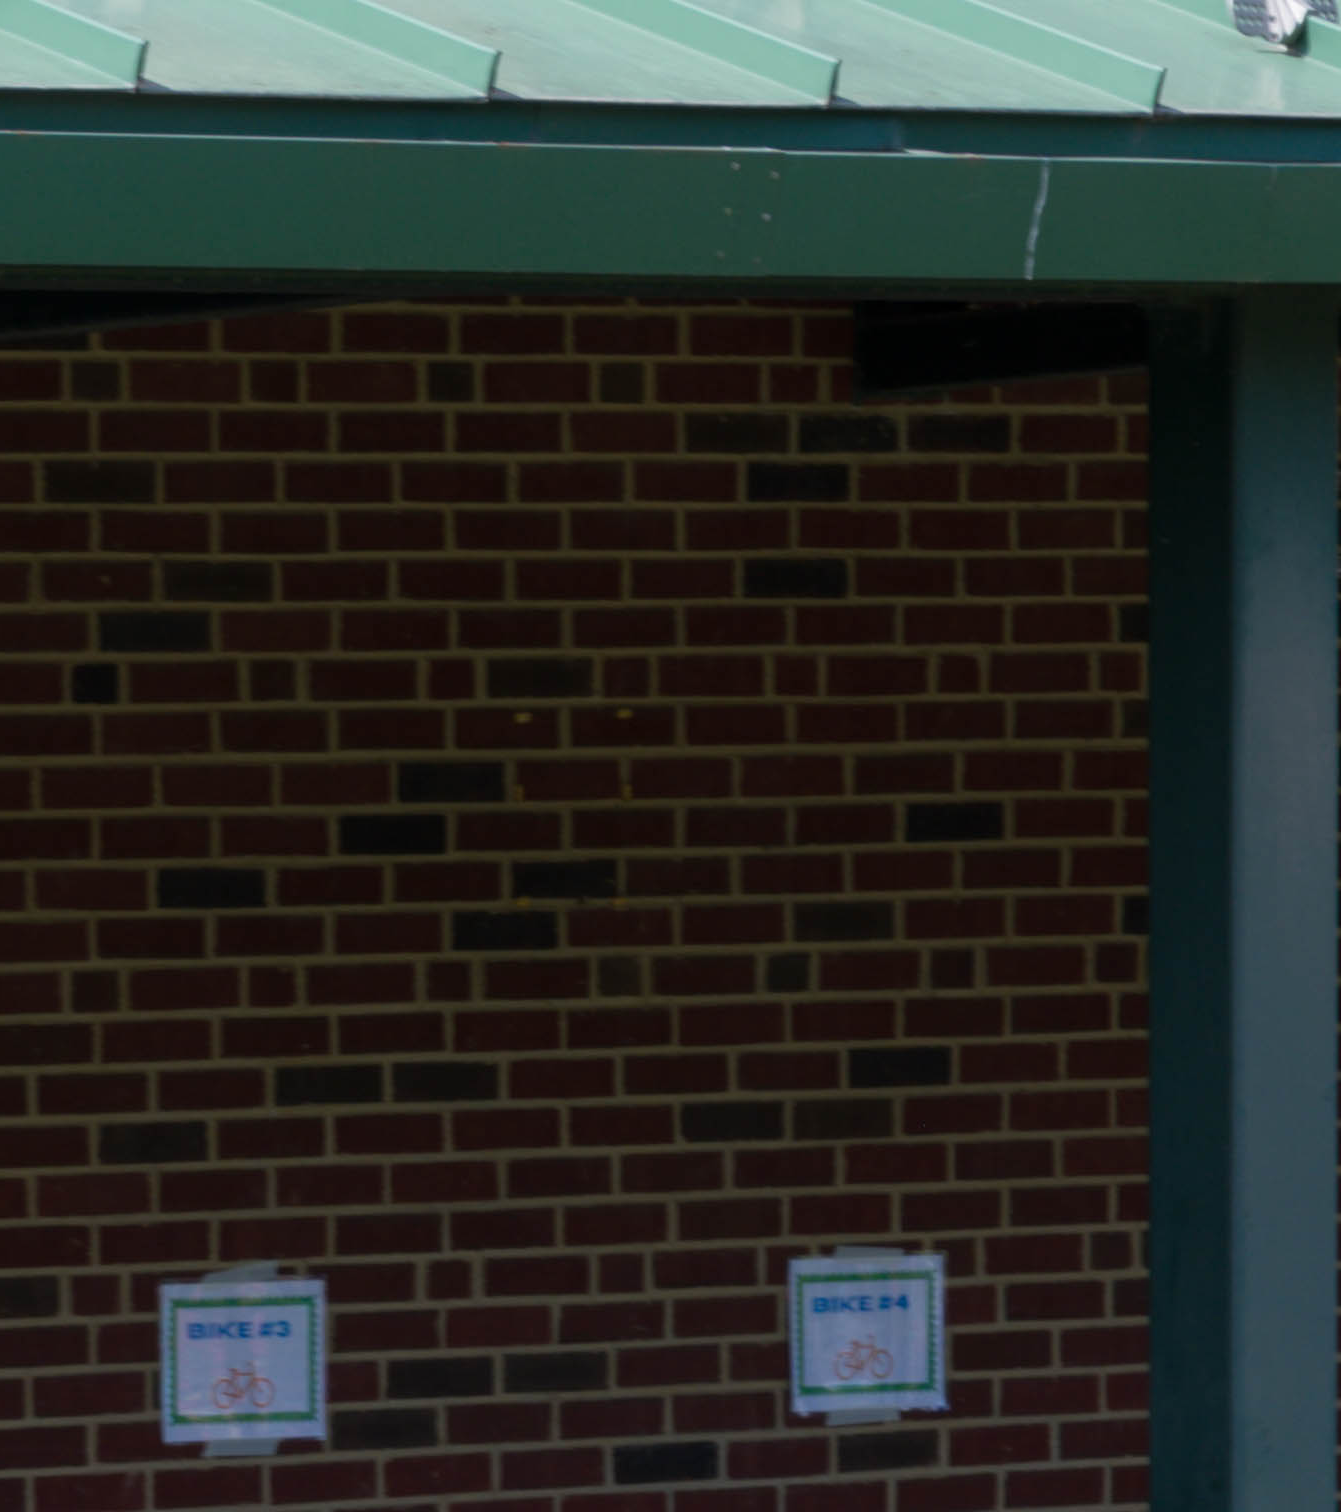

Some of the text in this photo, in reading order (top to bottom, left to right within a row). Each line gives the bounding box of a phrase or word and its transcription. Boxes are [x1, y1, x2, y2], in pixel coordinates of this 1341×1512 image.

[813, 1295, 909, 1315] BIKE #4
[188, 1320, 291, 1340] BIKE #3
